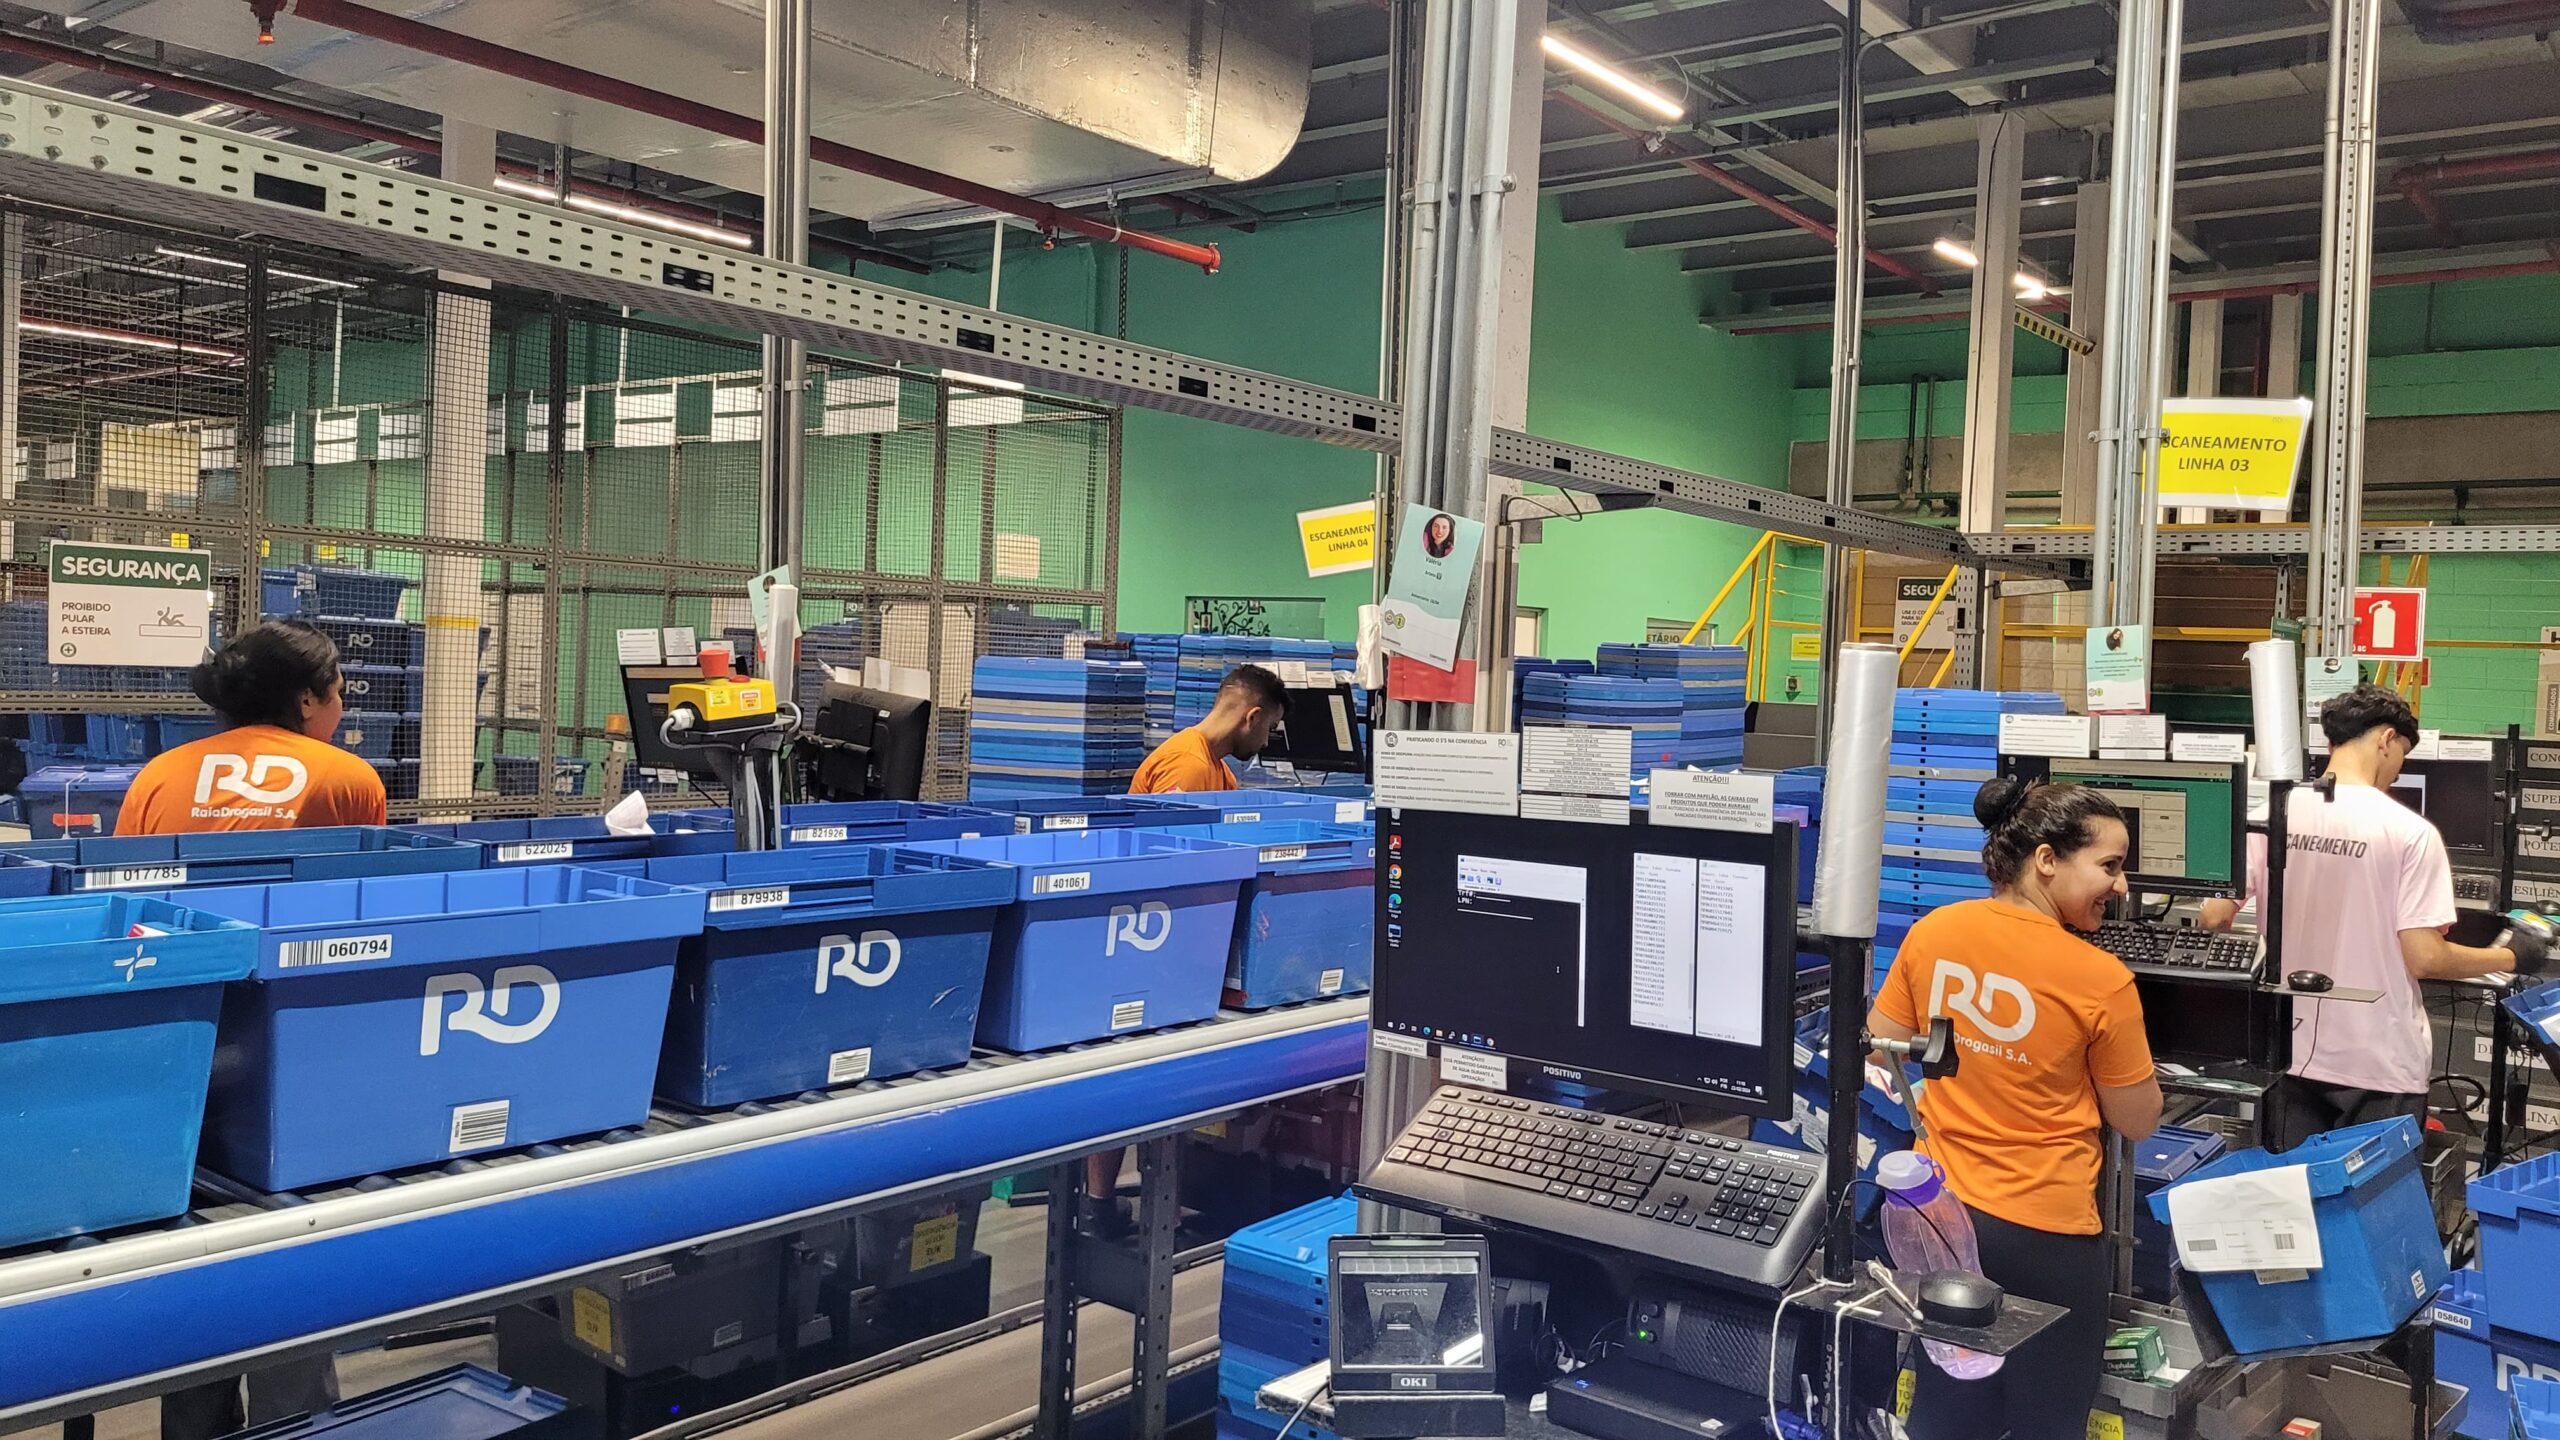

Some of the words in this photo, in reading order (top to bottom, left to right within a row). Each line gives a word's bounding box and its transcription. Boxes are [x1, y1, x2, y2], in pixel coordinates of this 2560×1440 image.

[2160, 435, 2287, 452] SCANEAMENTO
[2178, 457, 2224, 472] LINHA
[2230, 458, 2250, 472] 03
[1309, 523, 1376, 542] ESCANEAMENT
[1328, 540, 1356, 552] LINHA
[1357, 538, 1368, 548] 04
[61, 555, 202, 586] SEGURANÇA
[62, 602, 111, 612] PROIBIDO
[62, 614, 95, 623] PULAR
[62, 626, 69, 634] A
[72, 627, 111, 636] ESTEIRA
[348, 633, 374, 648] RD
[345, 680, 370, 695] RD
[194, 753, 308, 804] RD
[191, 806, 272, 819] RaiaDrogasil
[812, 827, 844, 839] 821926
[525, 842, 568, 856] 622025
[2286, 833, 2367, 859] CANEAMENTO
[122, 866, 181, 883] 017785
[1052, 876, 1085, 889] 401061
[741, 890, 783, 905] 879938
[1105, 901, 1172, 957] RD
[328, 938, 389, 958] 060794
[815, 930, 901, 995] RD
[1928, 958, 2037, 1042] RD
[419, 965, 561, 1056] RD
[2005, 1048, 2033, 1066] S.A.
[1543, 1065, 1582, 1080] POSITIVO
[1767, 1150, 1800, 1160] POSITIVO
[2437, 1311, 2469, 1327] 058640
[1400, 1377, 1428, 1387] OKI
